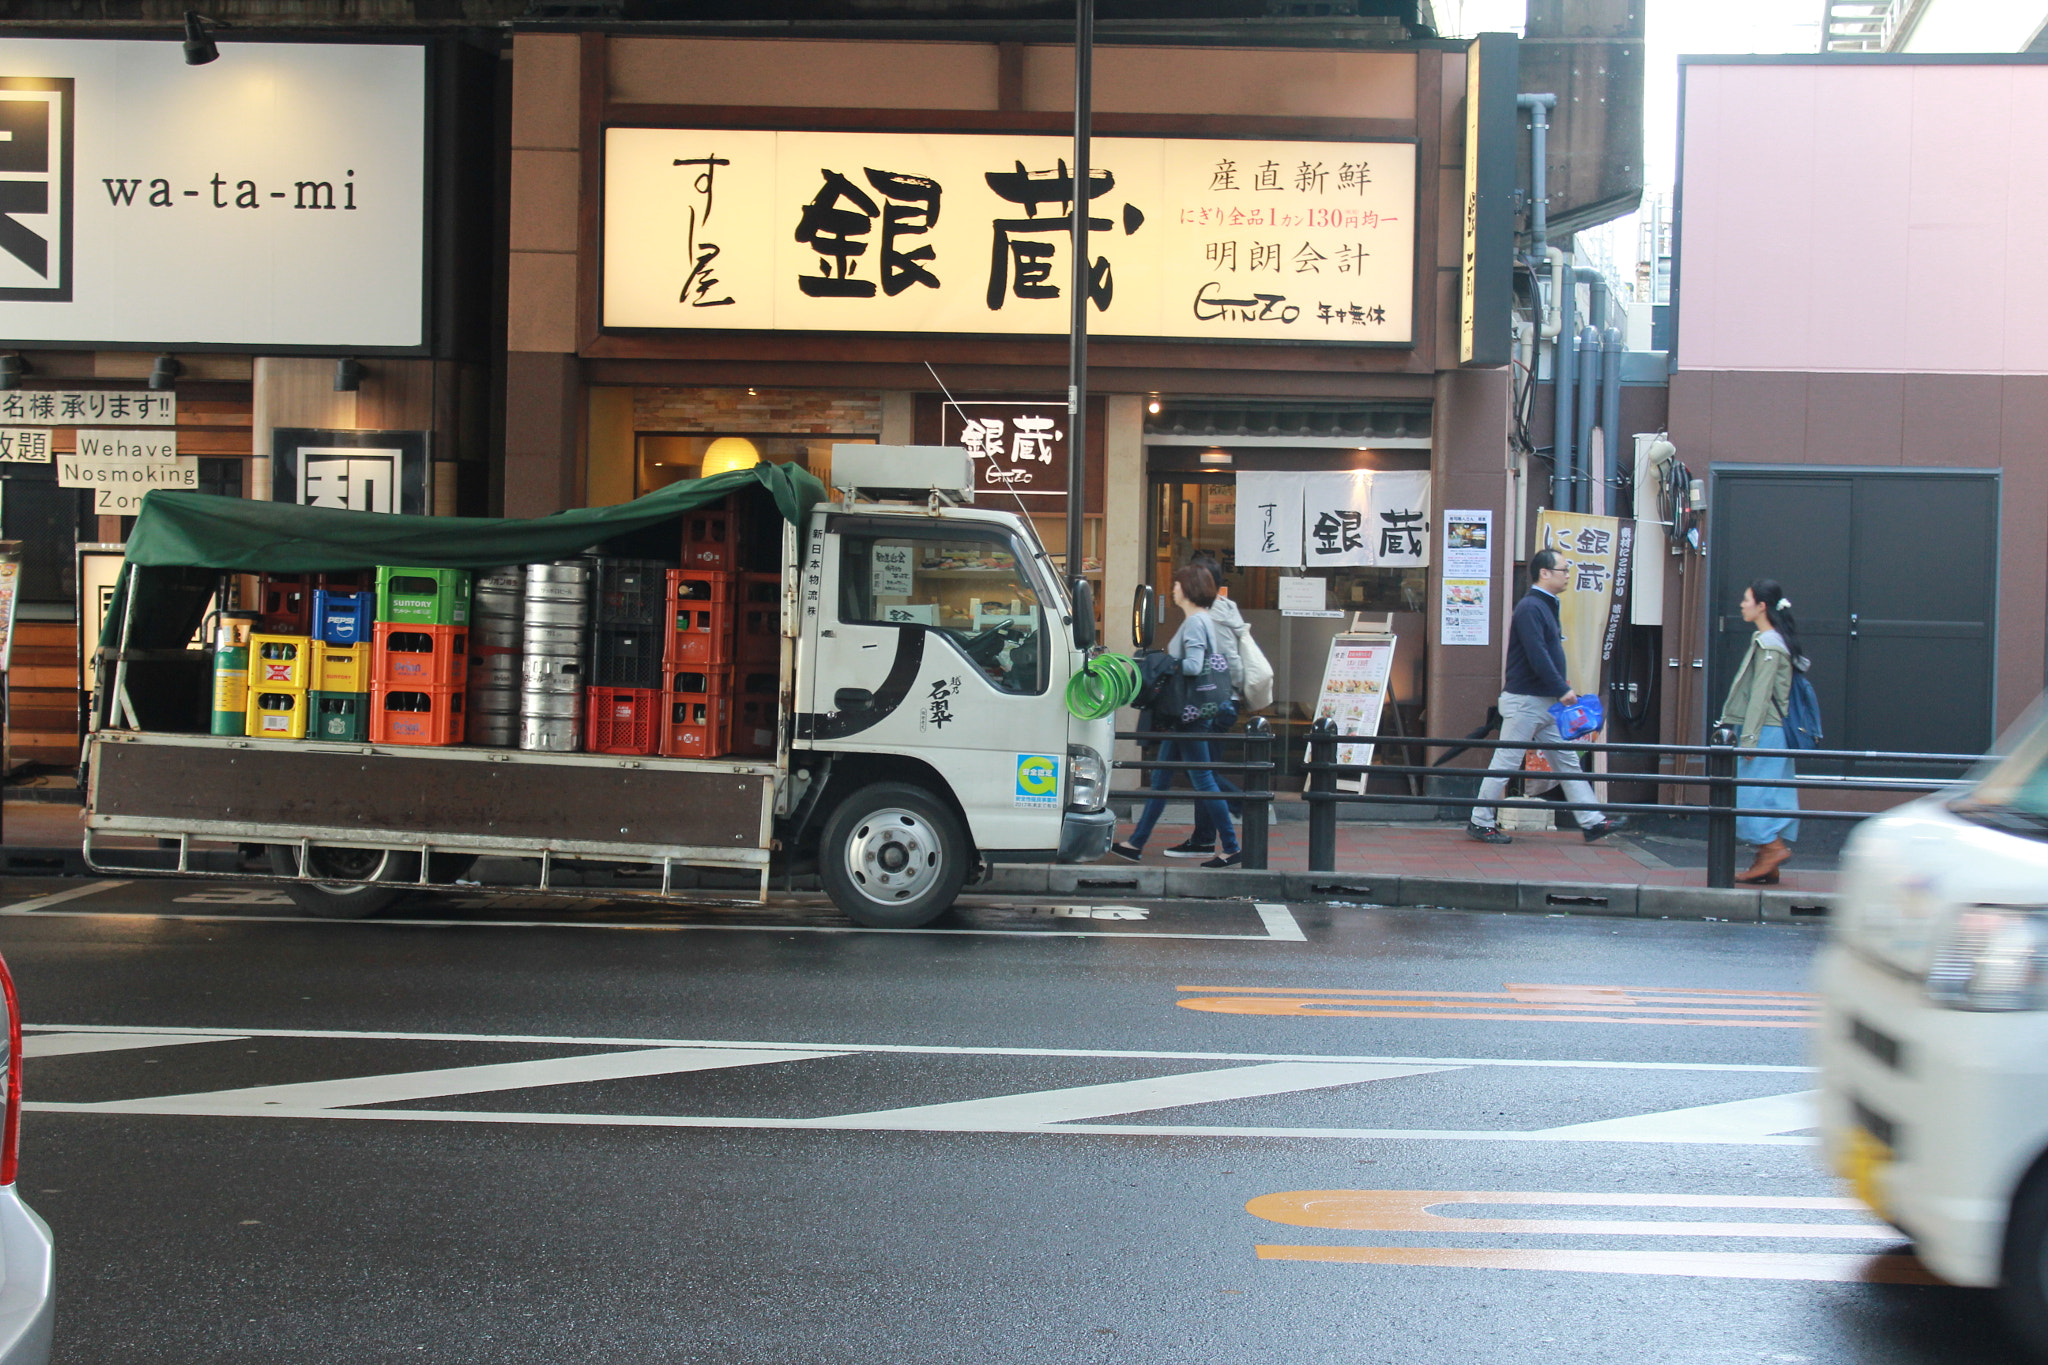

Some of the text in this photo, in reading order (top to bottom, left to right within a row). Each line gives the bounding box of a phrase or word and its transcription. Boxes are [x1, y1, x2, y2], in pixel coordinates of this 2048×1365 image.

[102, 169, 357, 210] wa-ta-mi
[1208, 157, 1372, 196] 産直新鮮
[673, 153, 736, 307] すし屋
[795, 158, 1145, 312] 銀蔵
[1205, 240, 1370, 276] 明朗会計
[1316, 300, 1387, 326] 年中無休
[960, 414, 1064, 465] 銀蔵
[98, 490, 143, 508] Zon
[1258, 503, 1281, 554] すし屋
[1313, 508, 1431, 558] 銀蔵
[807, 529, 823, 616] 新日本物流株
[1576, 527, 1611, 592] 銀蔵
[327, 616, 356, 625] PEPSI
[393, 600, 432, 608] SUNTORY
